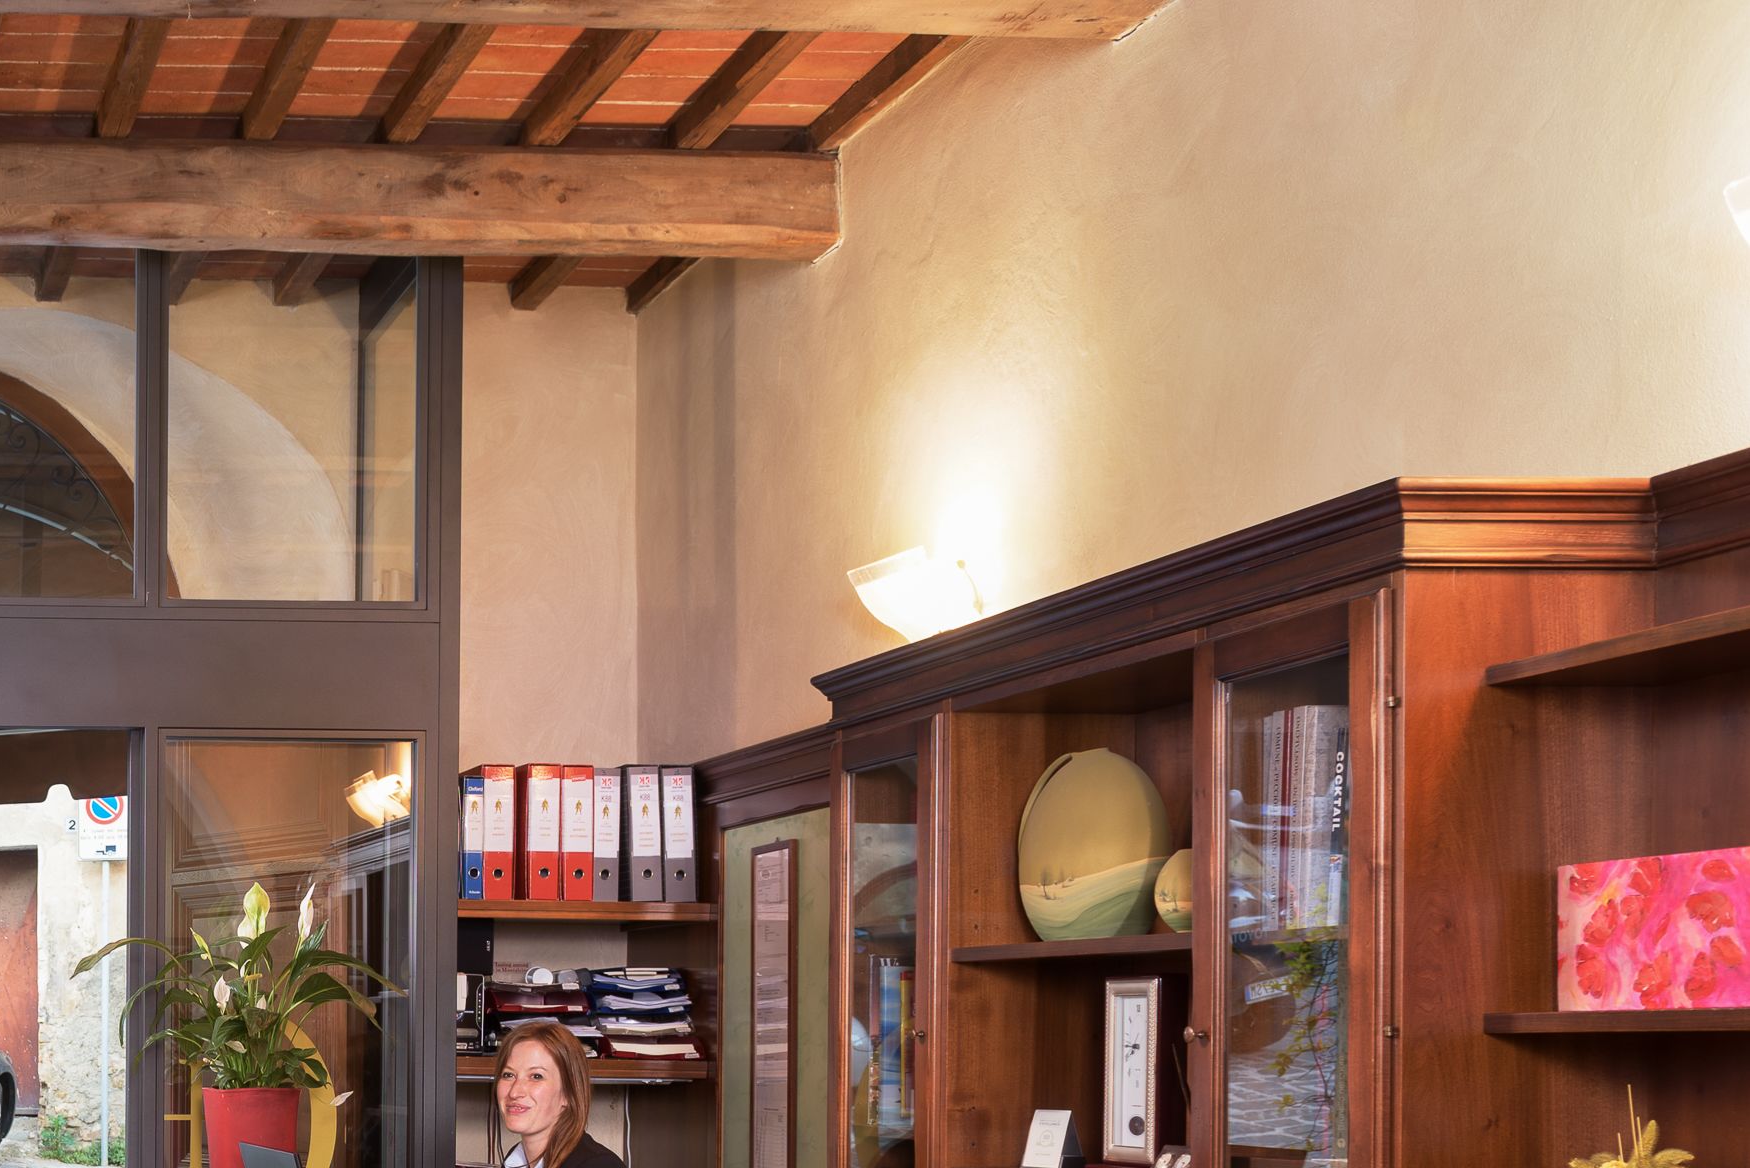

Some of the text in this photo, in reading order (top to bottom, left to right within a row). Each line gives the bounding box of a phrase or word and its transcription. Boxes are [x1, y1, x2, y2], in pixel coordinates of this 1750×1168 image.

[1274, 726, 1282, 764] COMUNE
[1331, 751, 1345, 832] COCKTAIL
[68, 819, 76, 830] 2
